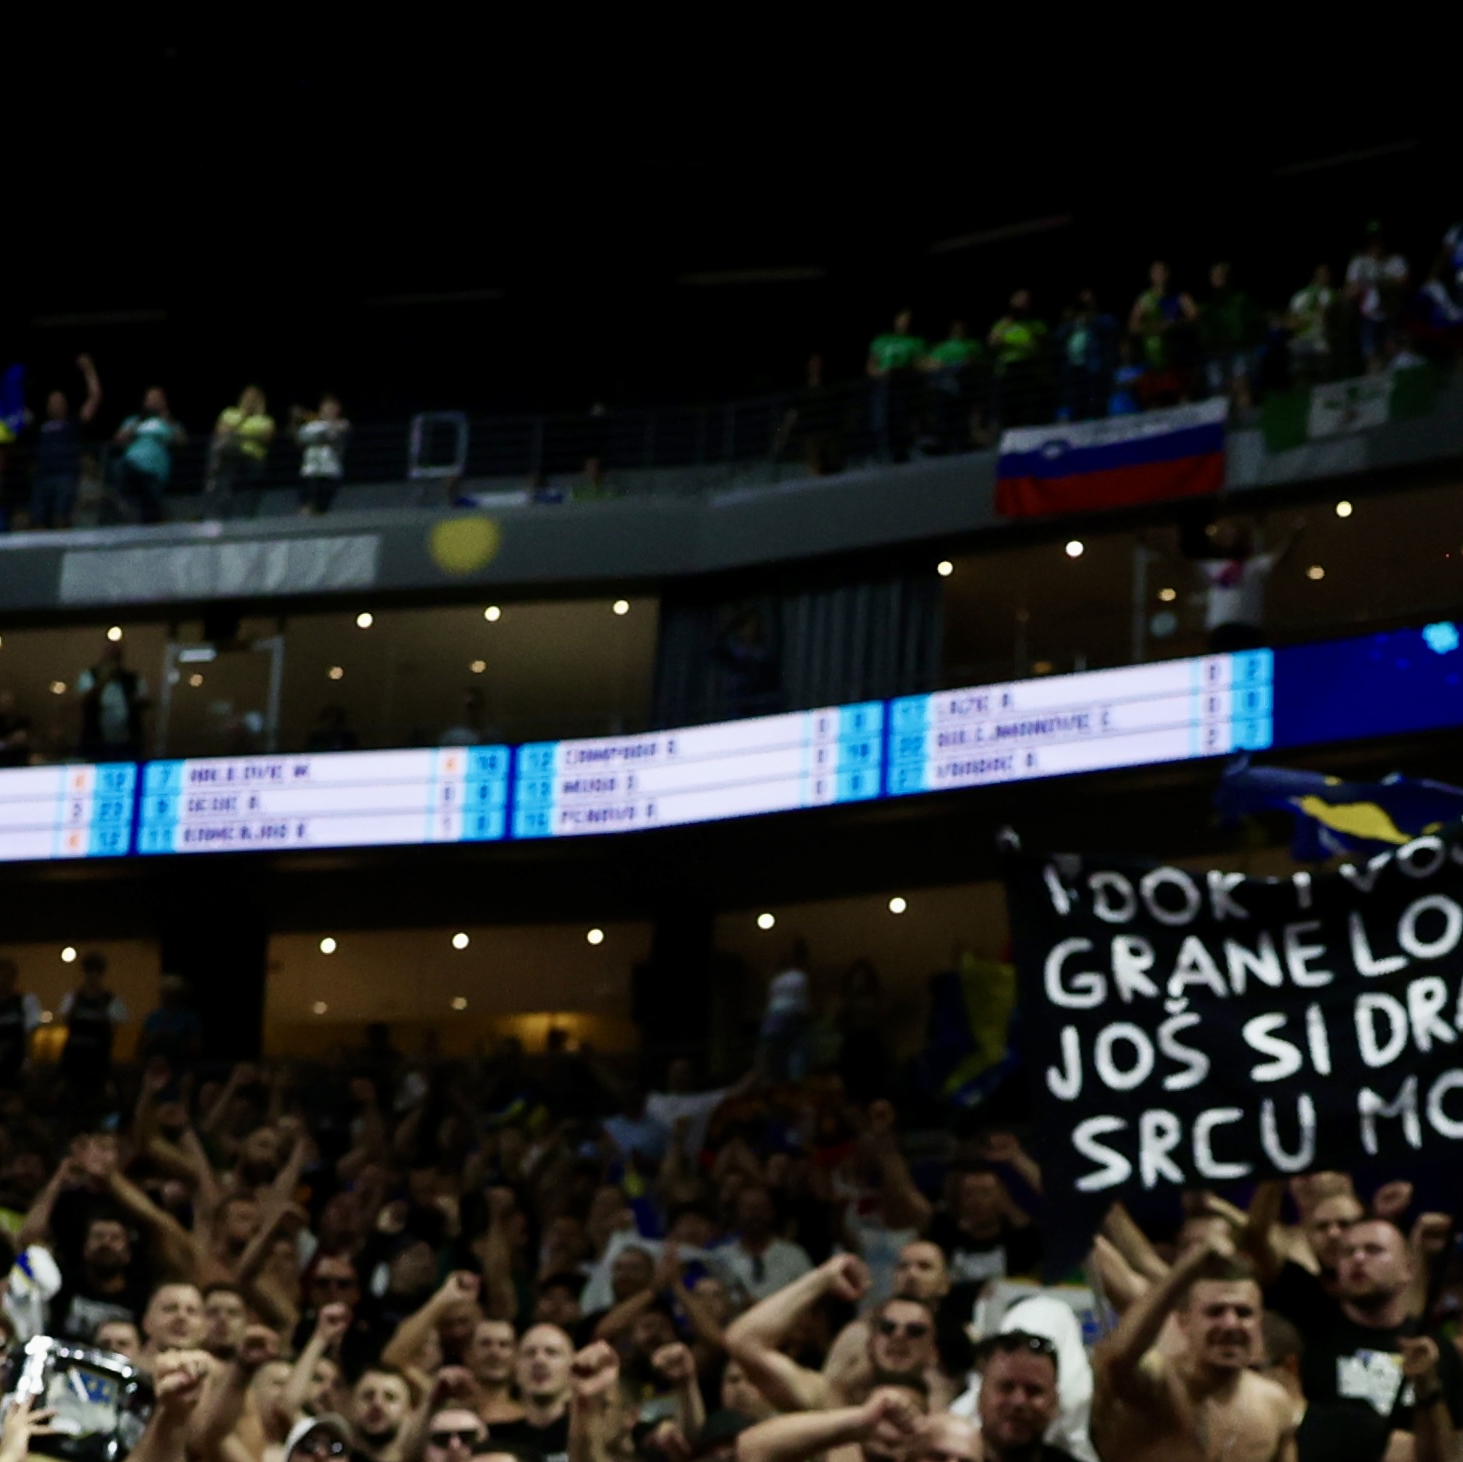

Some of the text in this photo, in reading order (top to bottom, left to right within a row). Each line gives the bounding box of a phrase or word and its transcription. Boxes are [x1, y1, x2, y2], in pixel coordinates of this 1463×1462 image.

[1044, 920, 1334, 1008] GRANE
[1047, 996, 1210, 1100] JOŠ
[1242, 1004, 1331, 1083] SI
[1071, 1095, 1316, 1191] SRCU
